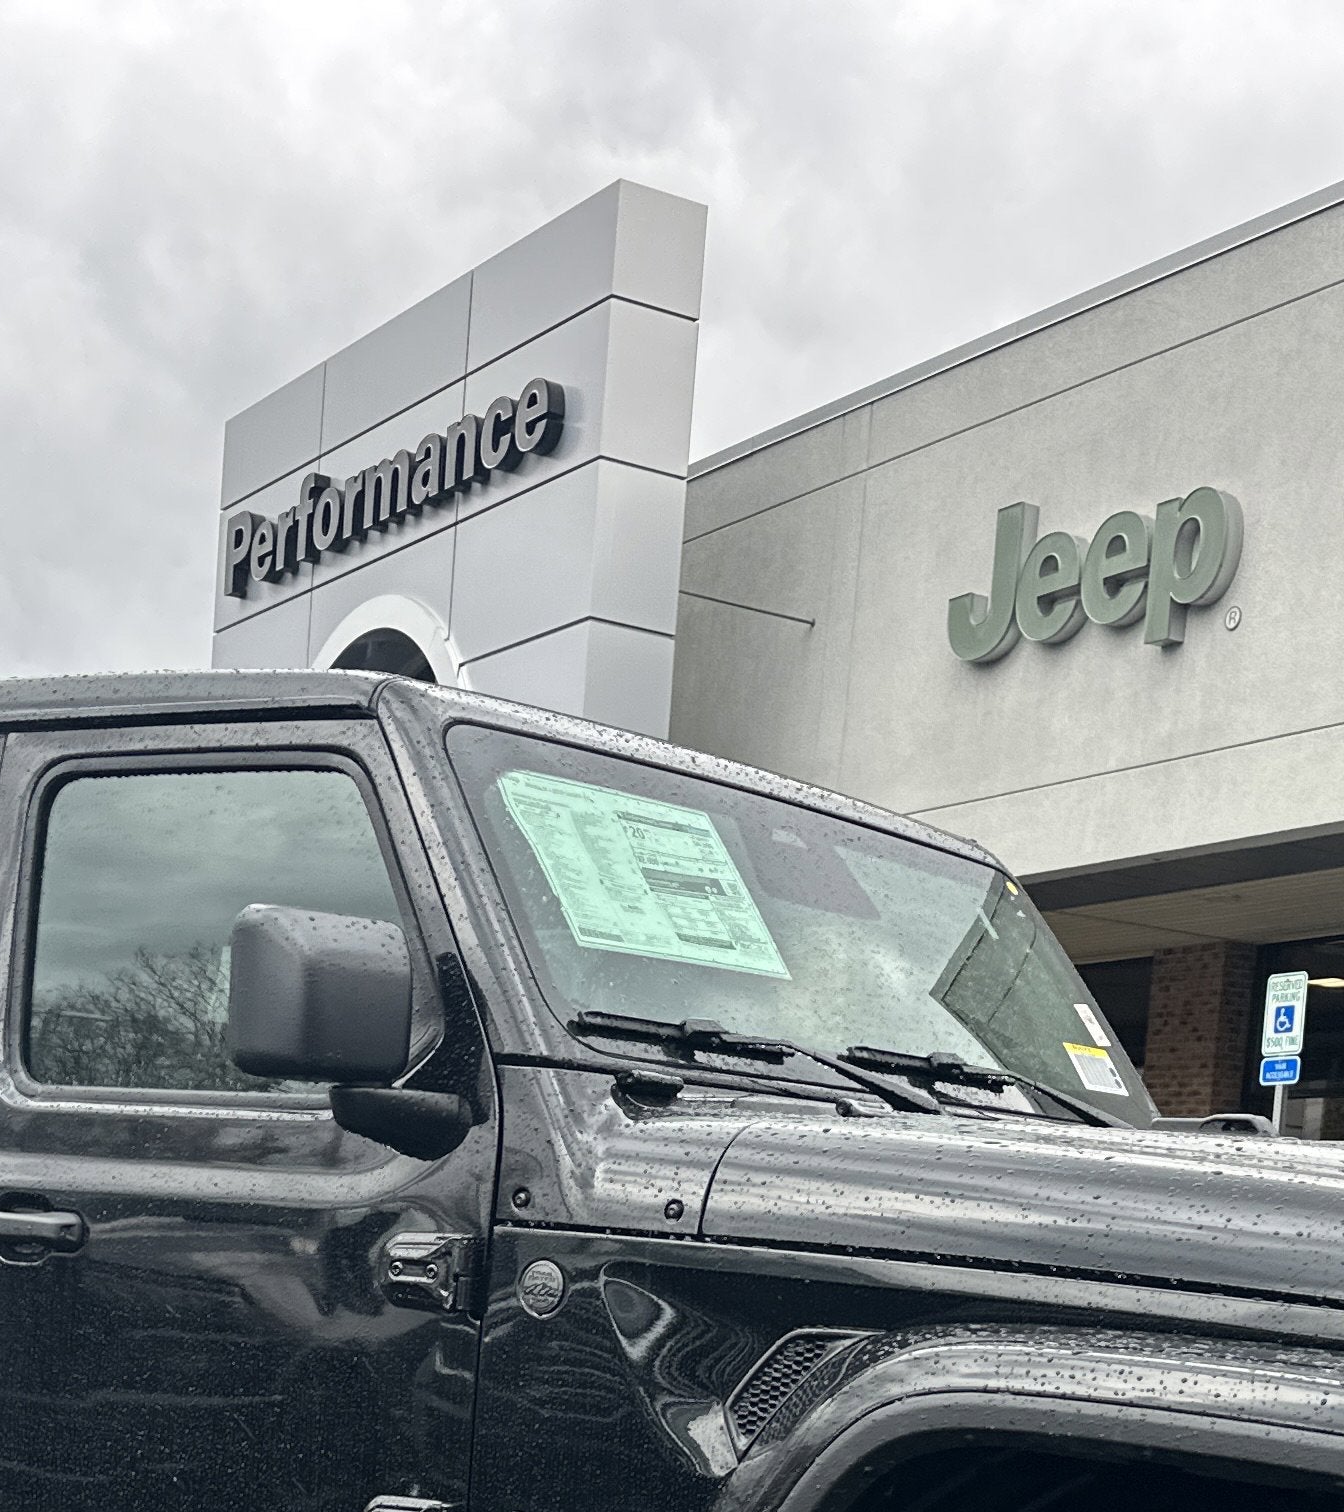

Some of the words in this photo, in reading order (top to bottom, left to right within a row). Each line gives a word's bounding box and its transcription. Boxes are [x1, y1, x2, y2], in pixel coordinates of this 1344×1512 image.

[223, 377, 566, 599] Performance
[947, 485, 1245, 663] Jeep
[1271, 979, 1303, 992] RESERVED
[1271, 992, 1301, 1003] PARKING
